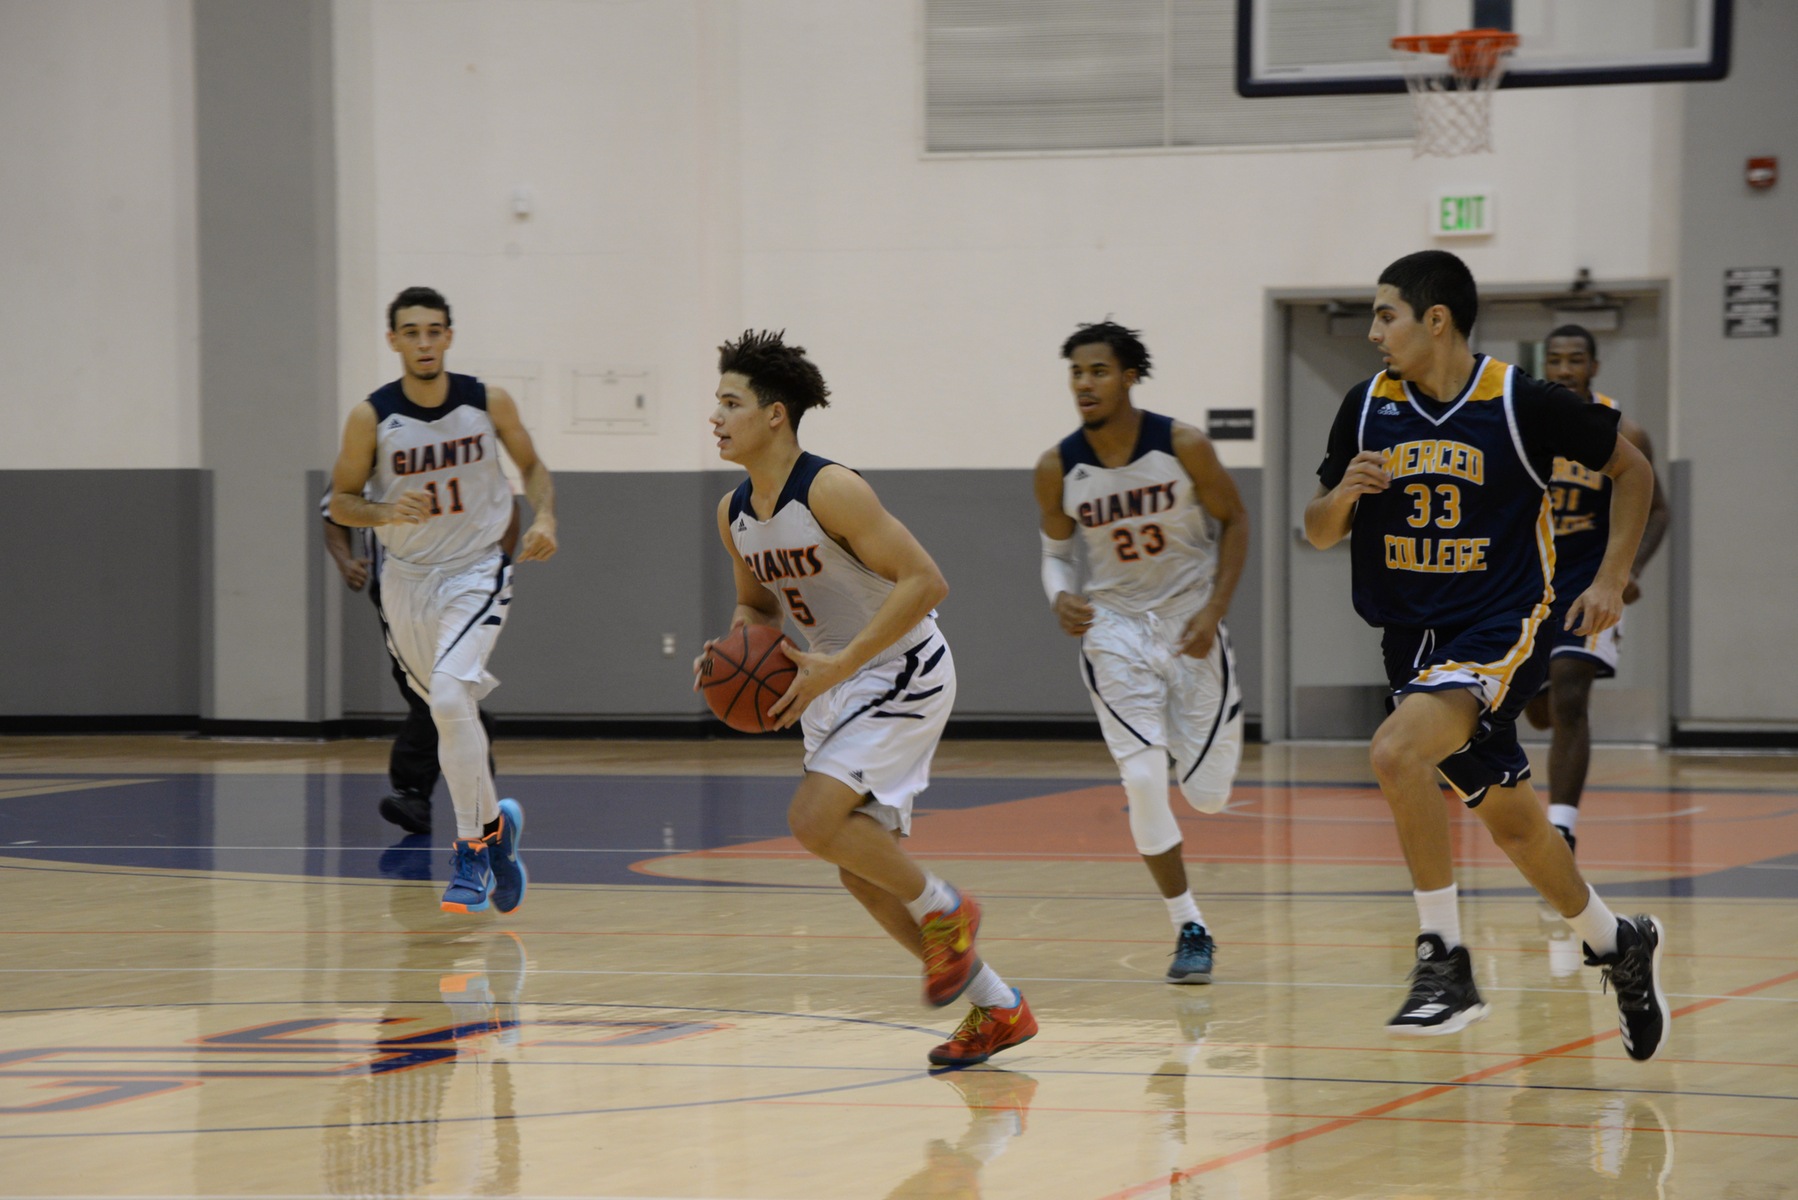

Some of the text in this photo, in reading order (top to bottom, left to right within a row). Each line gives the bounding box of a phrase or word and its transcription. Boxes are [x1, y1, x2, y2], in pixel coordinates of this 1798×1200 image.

[1440, 195, 1486, 231] EXIT
[391, 432, 486, 476] GIANTS
[1382, 439, 1485, 486] MERCED
[424, 477, 465, 517] 11
[1076, 480, 1178, 529] GIANTS
[1403, 483, 1462, 529] 33
[1110, 522, 1167, 563] 23
[1384, 534, 1491, 573] COLLEGE
[781, 587, 817, 627] 5
